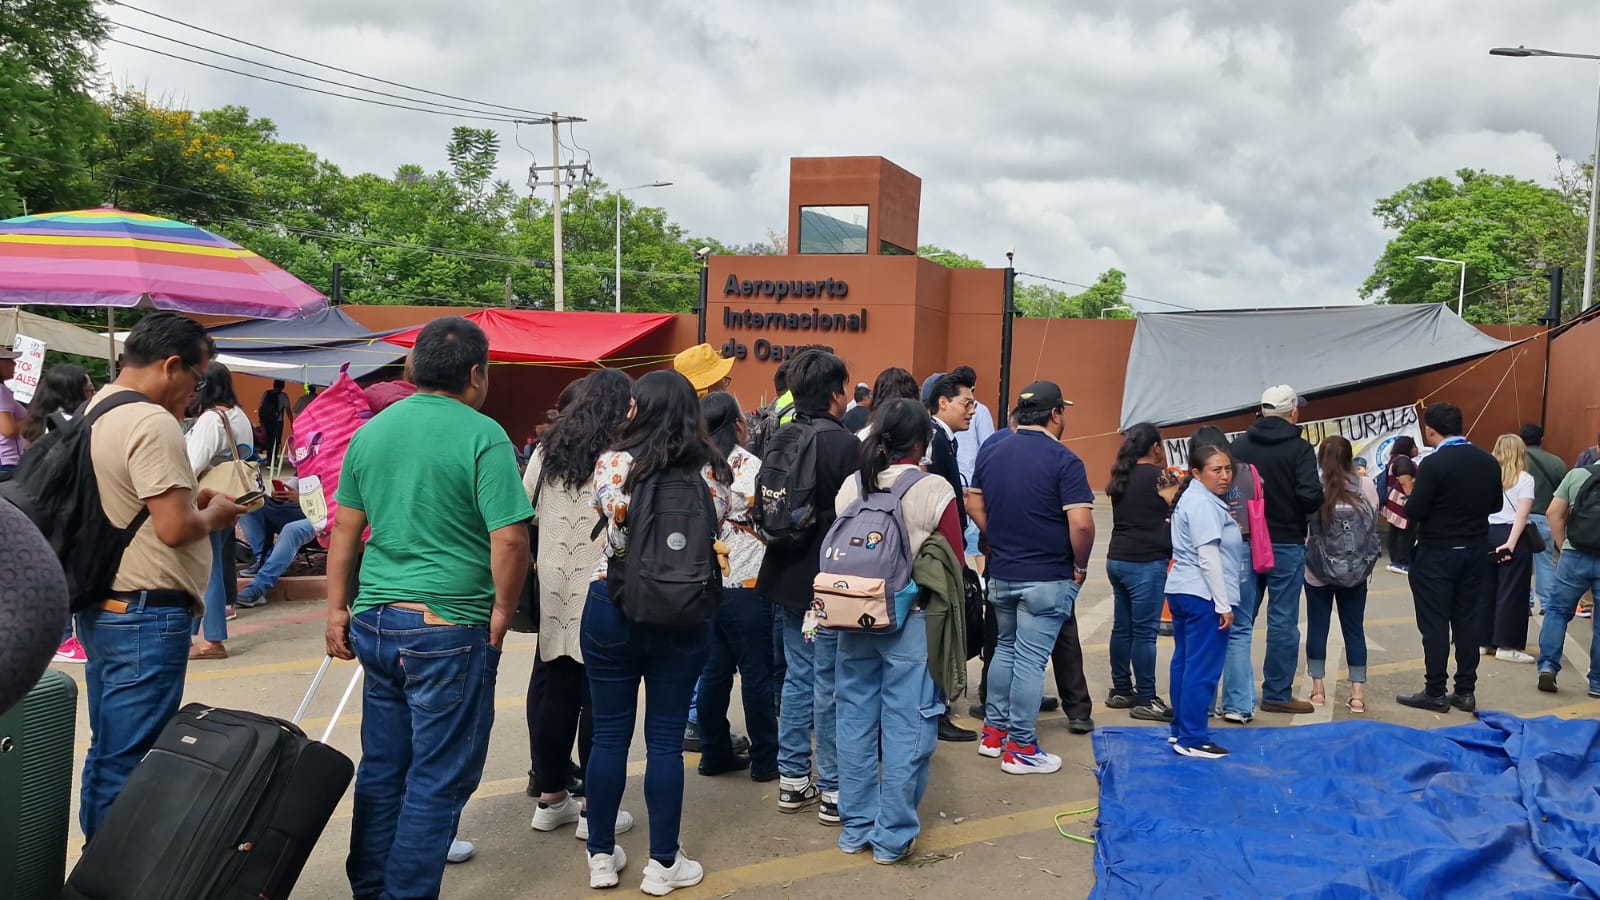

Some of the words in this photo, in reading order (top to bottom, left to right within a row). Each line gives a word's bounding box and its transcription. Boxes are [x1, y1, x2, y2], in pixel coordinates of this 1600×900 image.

[724, 274, 848, 301] Aeropuerto
[723, 306, 867, 330] Internacional
[722, 338, 746, 359] de
[754, 338, 833, 361] Oax
[1300, 405, 1418, 447] ULTURALES
